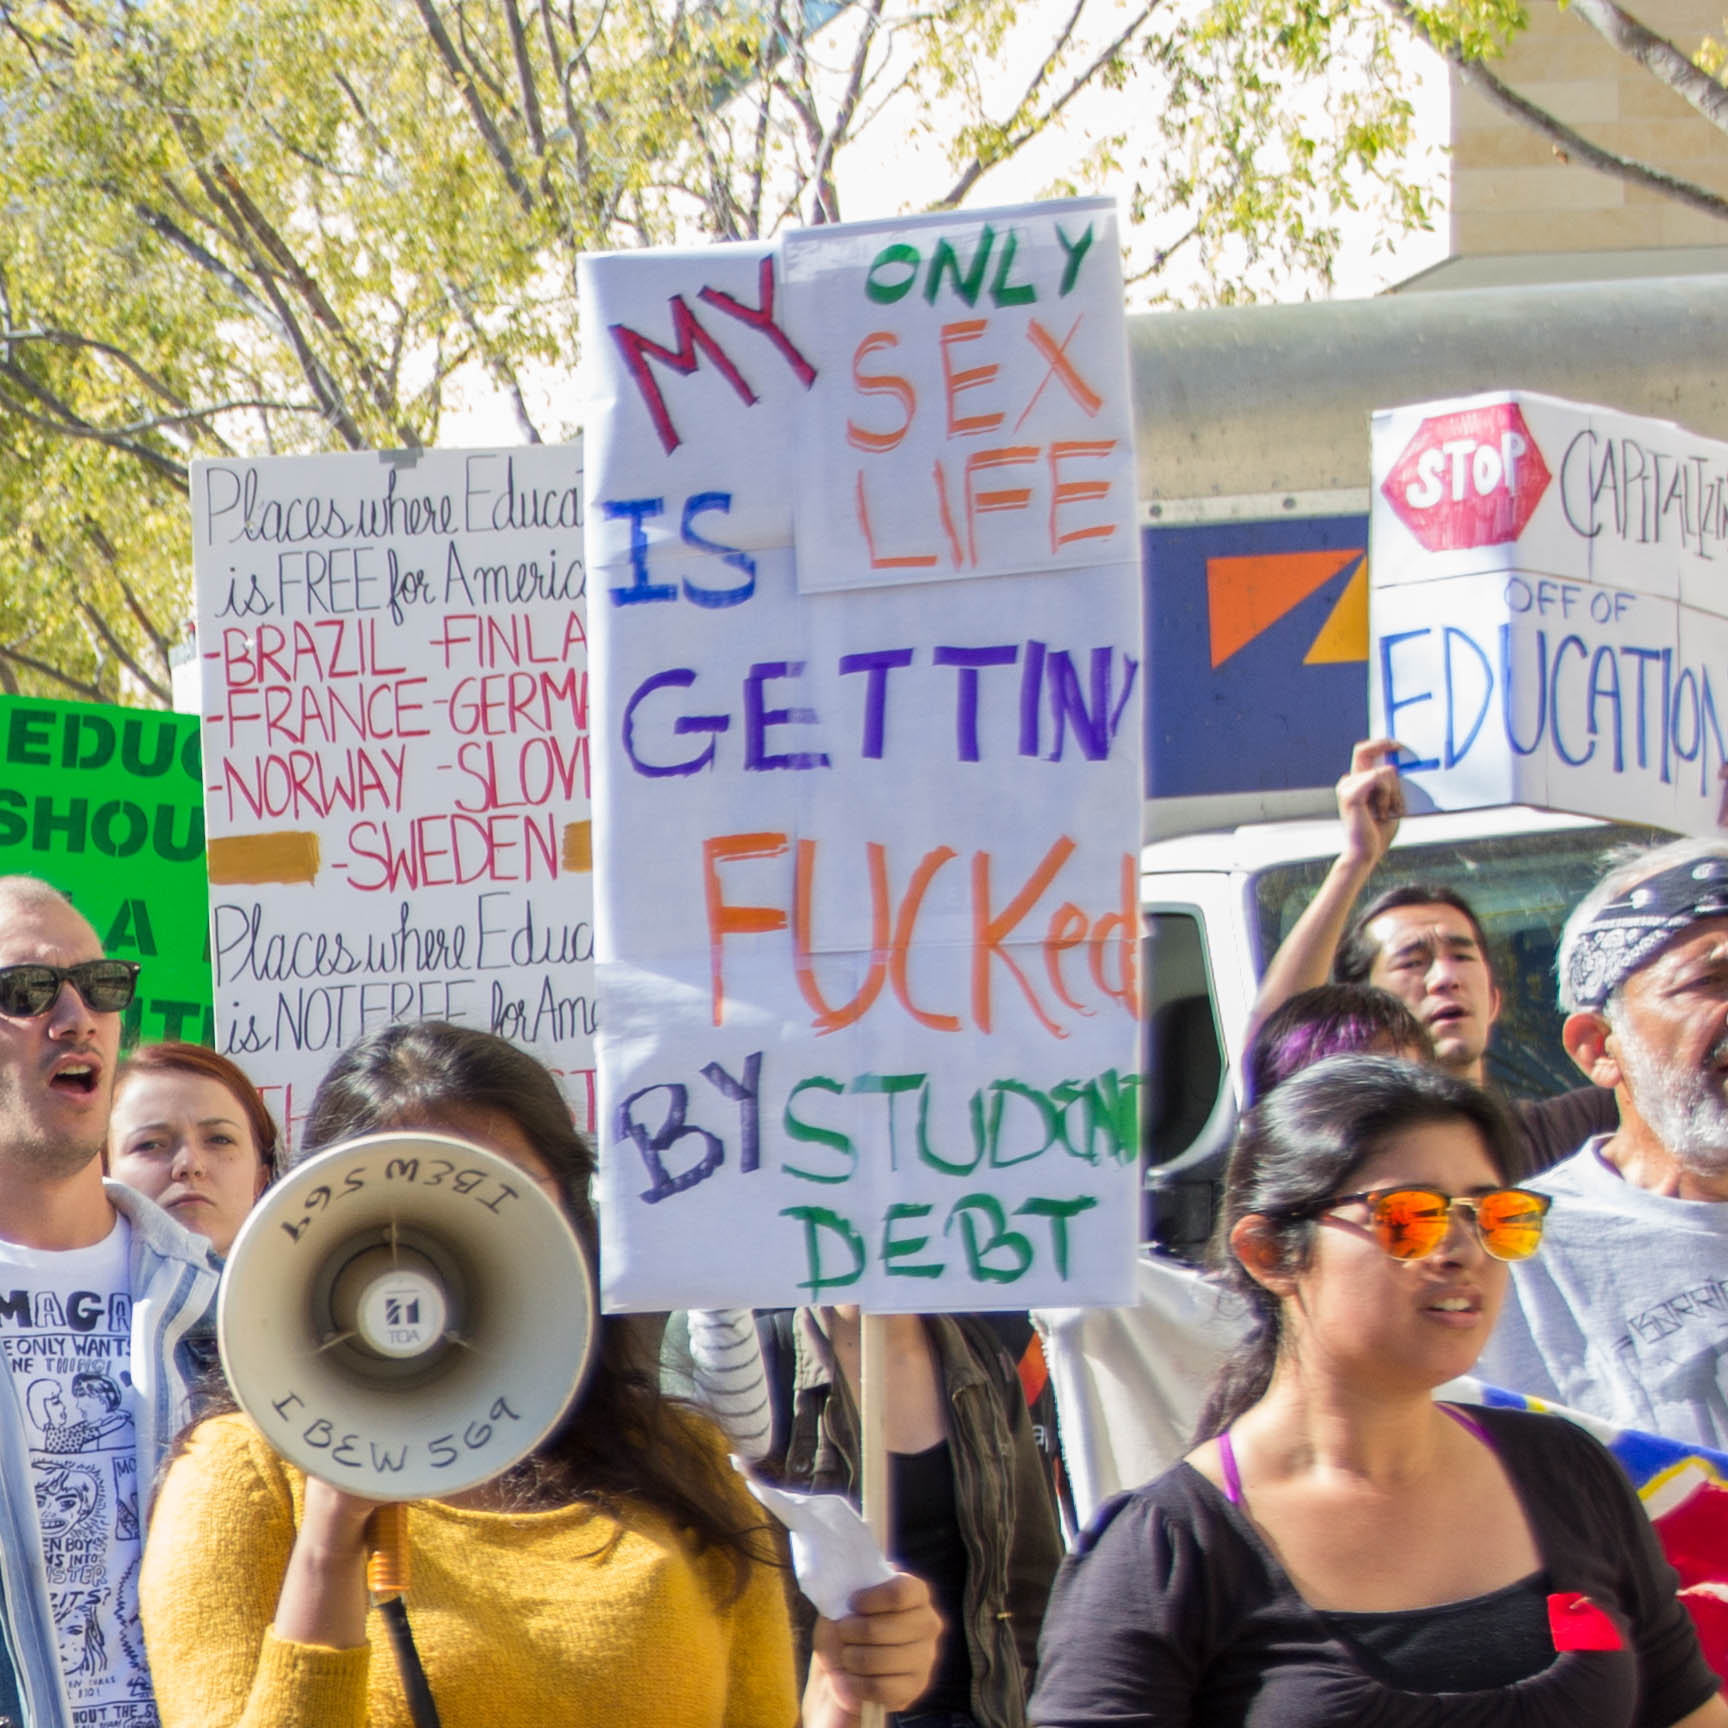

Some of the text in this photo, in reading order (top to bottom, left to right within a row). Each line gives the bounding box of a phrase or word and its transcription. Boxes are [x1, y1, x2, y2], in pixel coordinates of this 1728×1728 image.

[609, 222, 1094, 457] MY ONLY
[848, 313, 1104, 454] SEX
[205, 454, 585, 546] Places where Educa
[855, 438, 1118, 571] LIFE
[1405, 431, 1526, 510] STOP
[215, 541, 586, 627] is FREE for Americ
[604, 491, 756, 609] IS
[429, 611, 587, 669] -FINLA
[1504, 576, 1637, 624] OFF OF
[6, 709, 203, 783] EDUC
[1380, 623, 1728, 798] EDUCATION
[437, 736, 590, 814] -SLOV
[214, 891, 595, 986] Places where Educ
[220, 1000, 273, 1056] is
[615, 1051, 765, 1205] BY
[779, 1194, 1099, 1304] DEBT
[17, 1337, 65, 1357] ONLY
